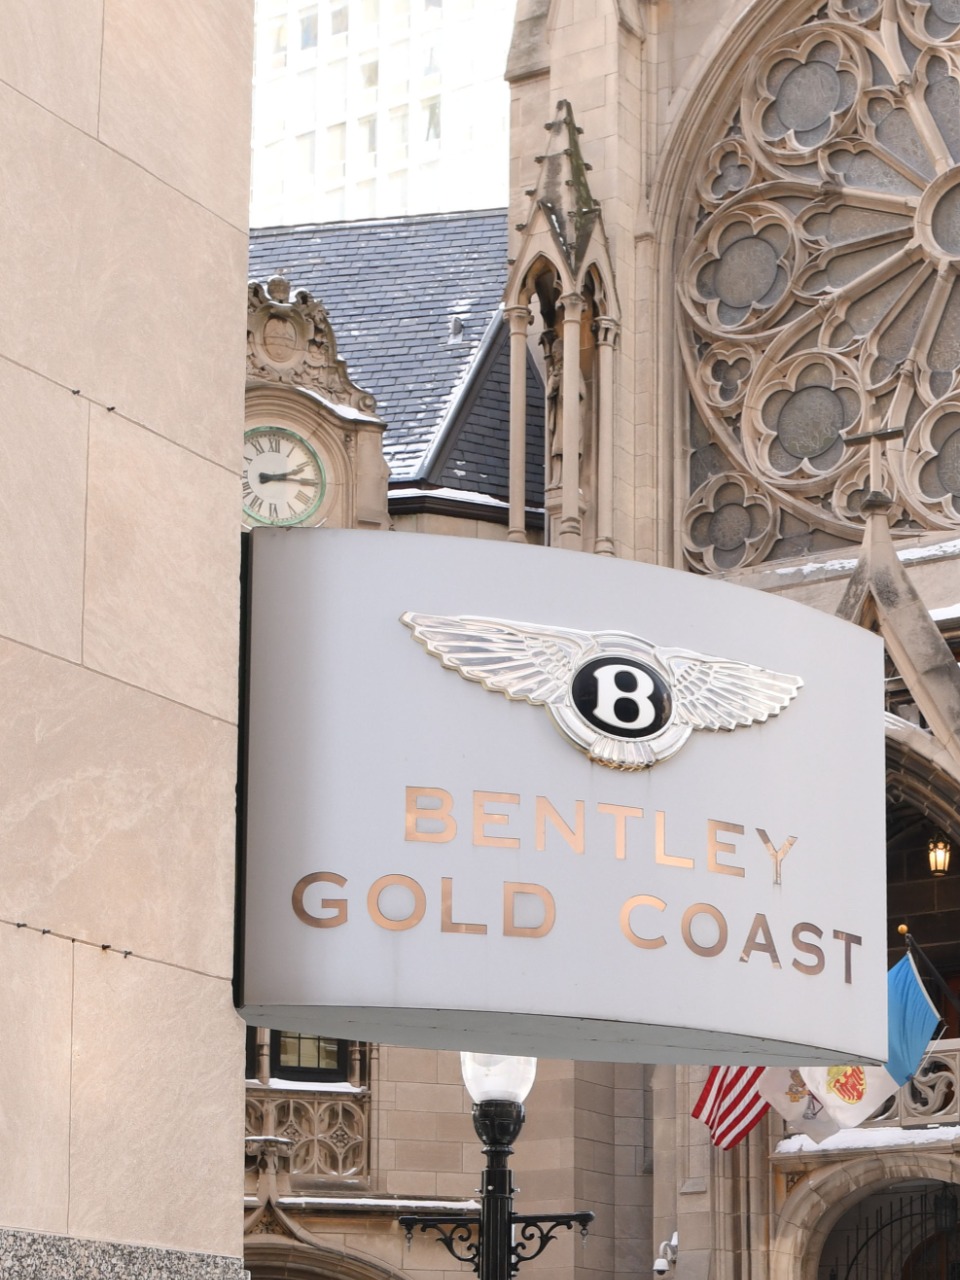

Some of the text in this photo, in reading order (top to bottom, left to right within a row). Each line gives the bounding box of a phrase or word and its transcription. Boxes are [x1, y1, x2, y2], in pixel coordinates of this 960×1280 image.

[592, 664, 656, 730] B
[404, 785, 798, 886] BENTLEY
[291, 871, 863, 985] GOLD COAST
